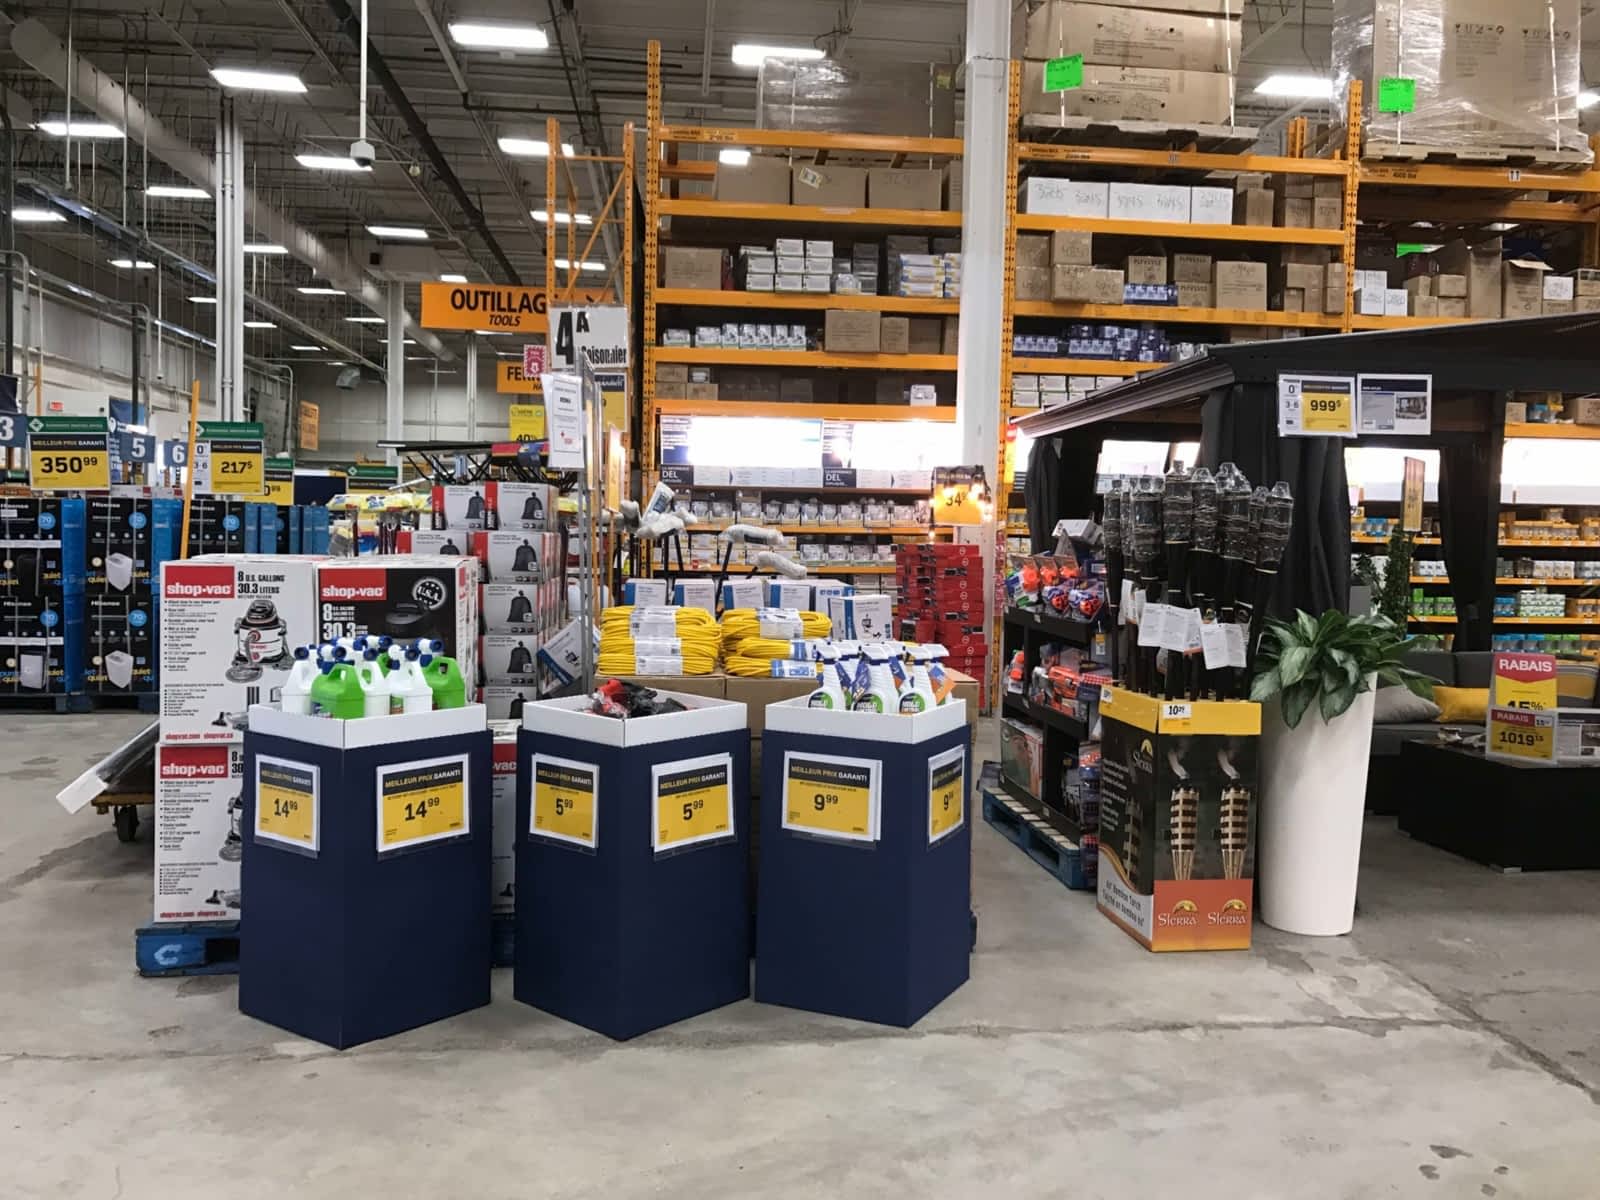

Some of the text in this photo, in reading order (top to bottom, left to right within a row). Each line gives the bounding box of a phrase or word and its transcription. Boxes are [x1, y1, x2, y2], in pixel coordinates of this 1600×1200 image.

[451, 289, 546, 314] OUTILLAG
[489, 315, 521, 327] TOOLS
[0, 416, 14, 441] 3
[131, 437, 146, 458] 5
[172, 445, 184, 464] 6
[238, 571, 244, 582] 8
[238, 583, 258, 594] 30.3
[323, 603, 332, 621] 8
[323, 622, 356, 640] 303
[1499, 659, 1552, 673] RABAIS
[232, 752, 238, 761] 8
[385, 777, 417, 788] MEILLEUR
[433, 769, 461, 780] GARANTI
[701, 772, 725, 782] GARANTI
[792, 766, 821, 776] MEILLEUR
[838, 772, 868, 782] GARANTI
